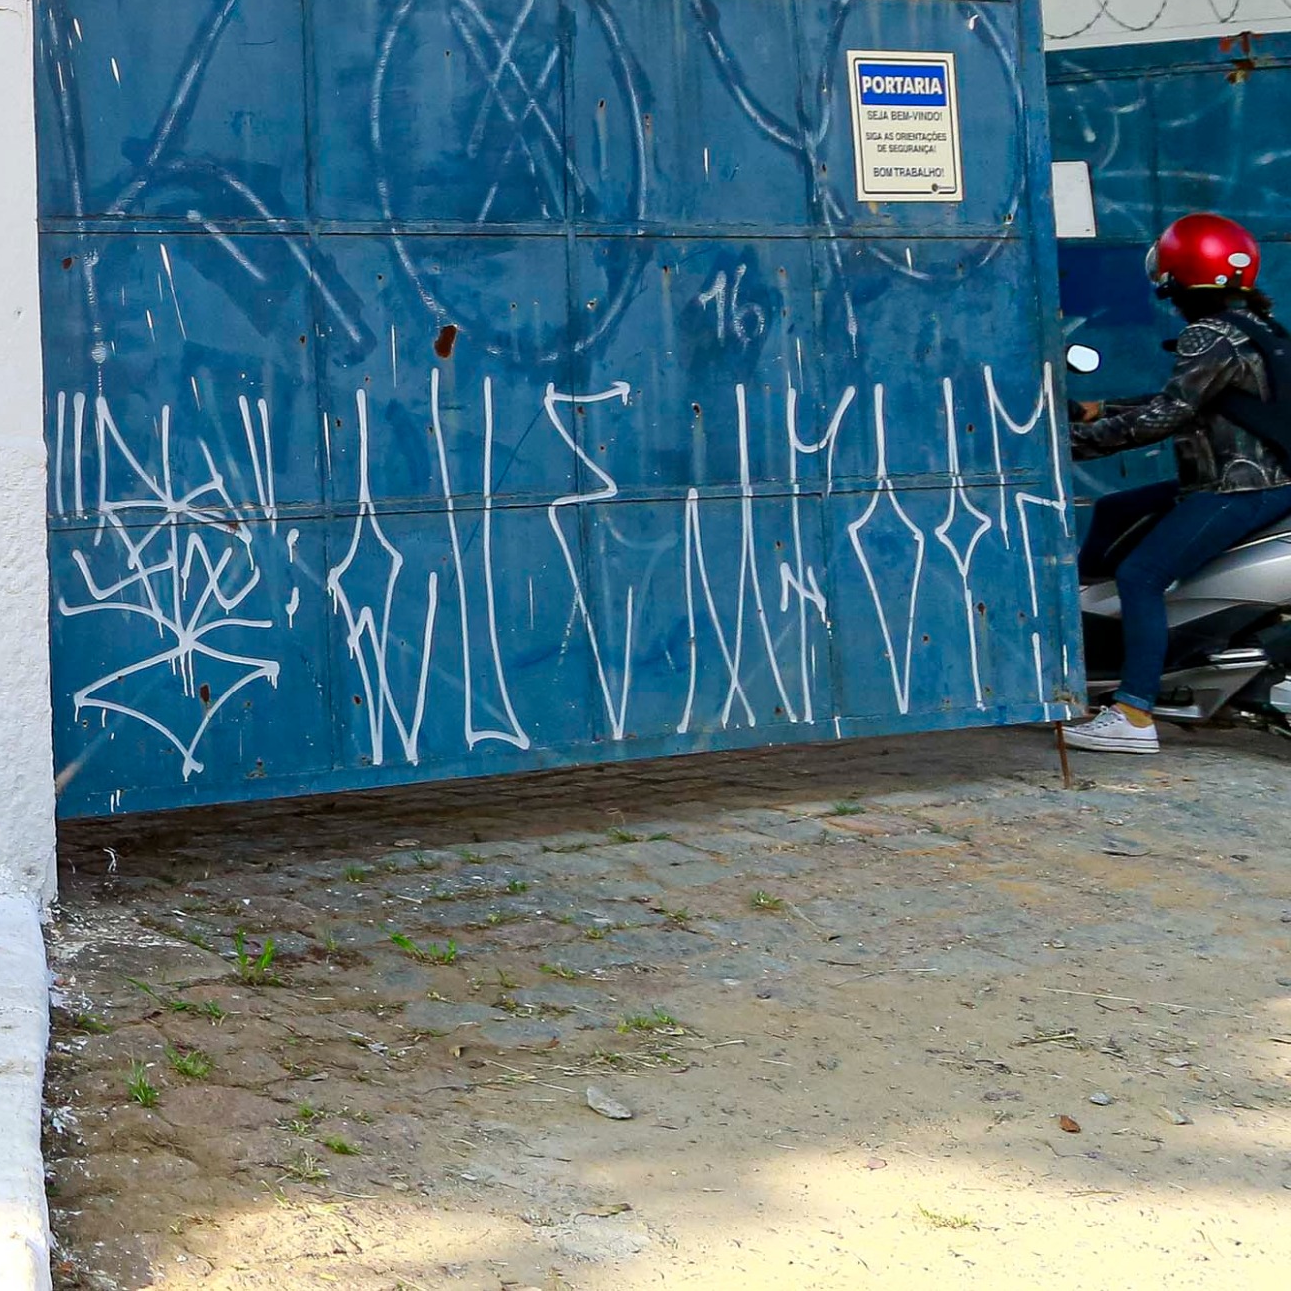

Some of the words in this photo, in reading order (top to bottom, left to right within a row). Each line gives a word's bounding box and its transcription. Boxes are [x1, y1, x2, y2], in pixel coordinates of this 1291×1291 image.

[861, 75, 943, 95] PORTARIA
[867, 110, 889, 120] SEJA
[891, 111, 943, 121] BEM-VINDO!
[866, 132, 882, 141] SIGA
[884, 132, 894, 141] AS
[877, 144, 887, 153] DE
[873, 167, 893, 177] BOM
[893, 167, 945, 178] TRABALHO!
[699, 262, 765, 348] 16
